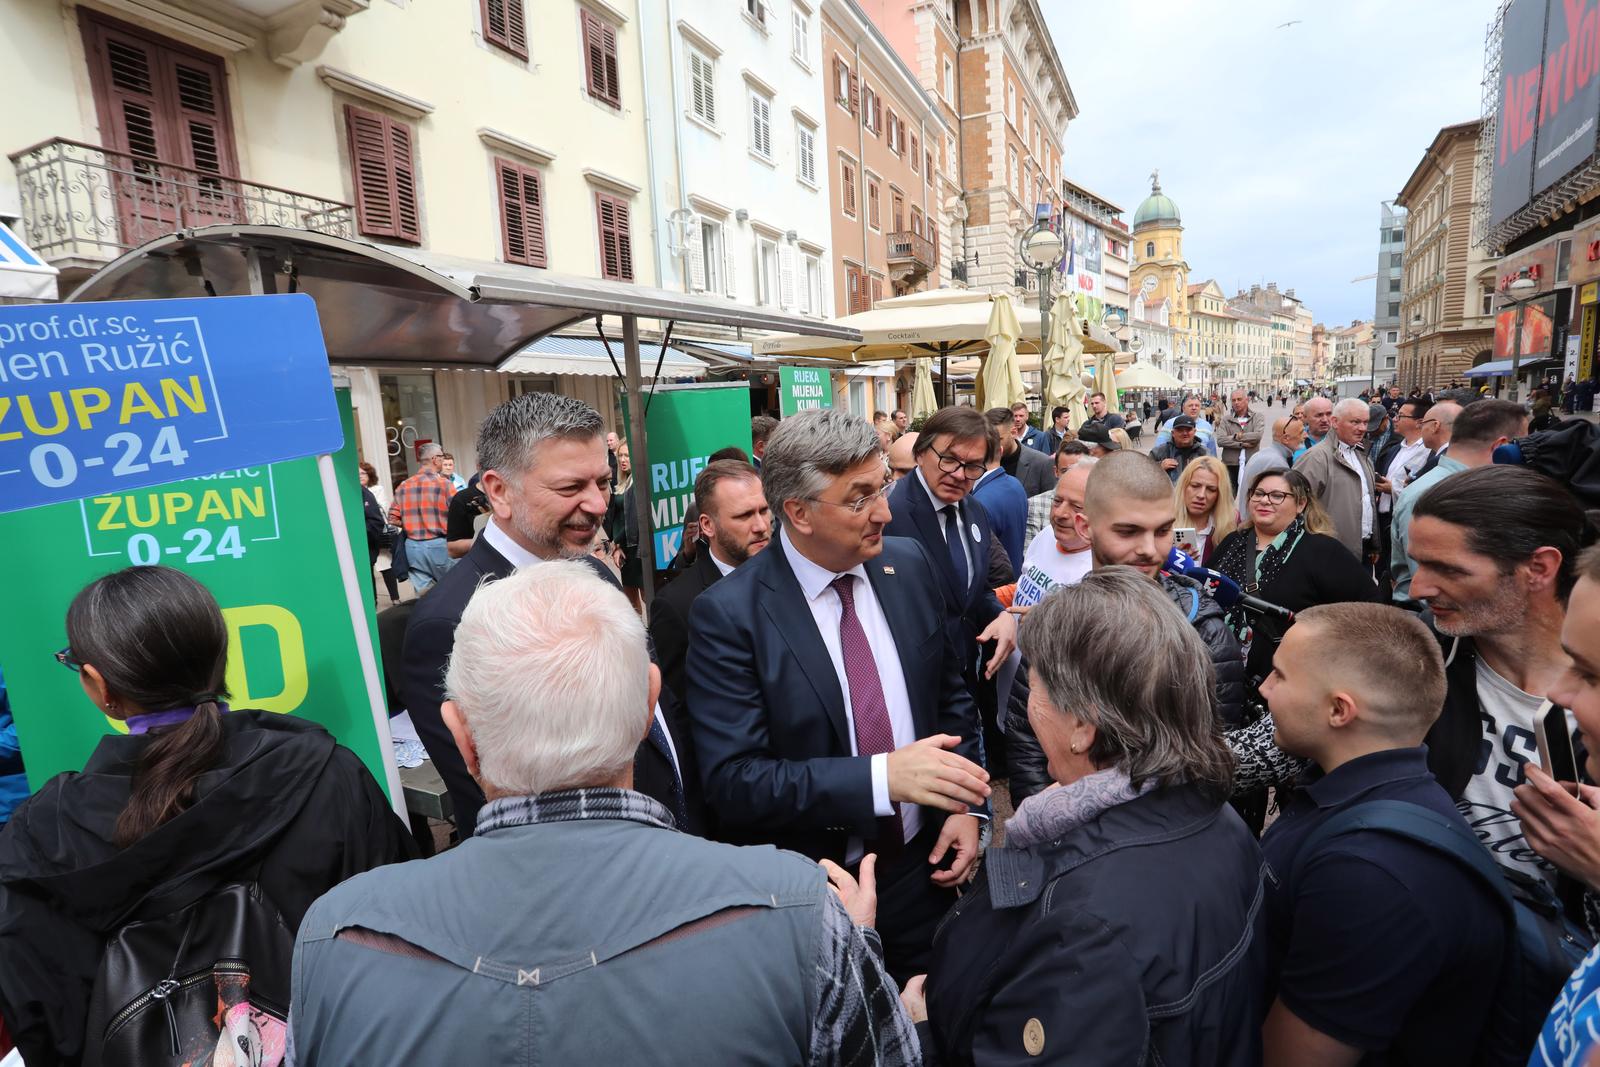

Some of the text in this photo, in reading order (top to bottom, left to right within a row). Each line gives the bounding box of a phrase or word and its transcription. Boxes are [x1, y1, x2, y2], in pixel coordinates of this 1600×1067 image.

[1563, 0, 1600, 103] YO
[0, 314, 146, 348] prof.dr.sc.
[887, 331, 921, 341] Cocktail's
[80, 332, 193, 374] Ružić
[792, 384, 824, 398] MIJENJA
[793, 370, 820, 383] RIJEKA
[29, 425, 189, 488] 0-24
[385, 426, 419, 456] 30
[651, 455, 711, 493] RIJE
[650, 492, 697, 529] MIJ
[127, 525, 246, 567] 0-24
[661, 530, 684, 563] K
[1019, 575, 1044, 603] MIJEN
